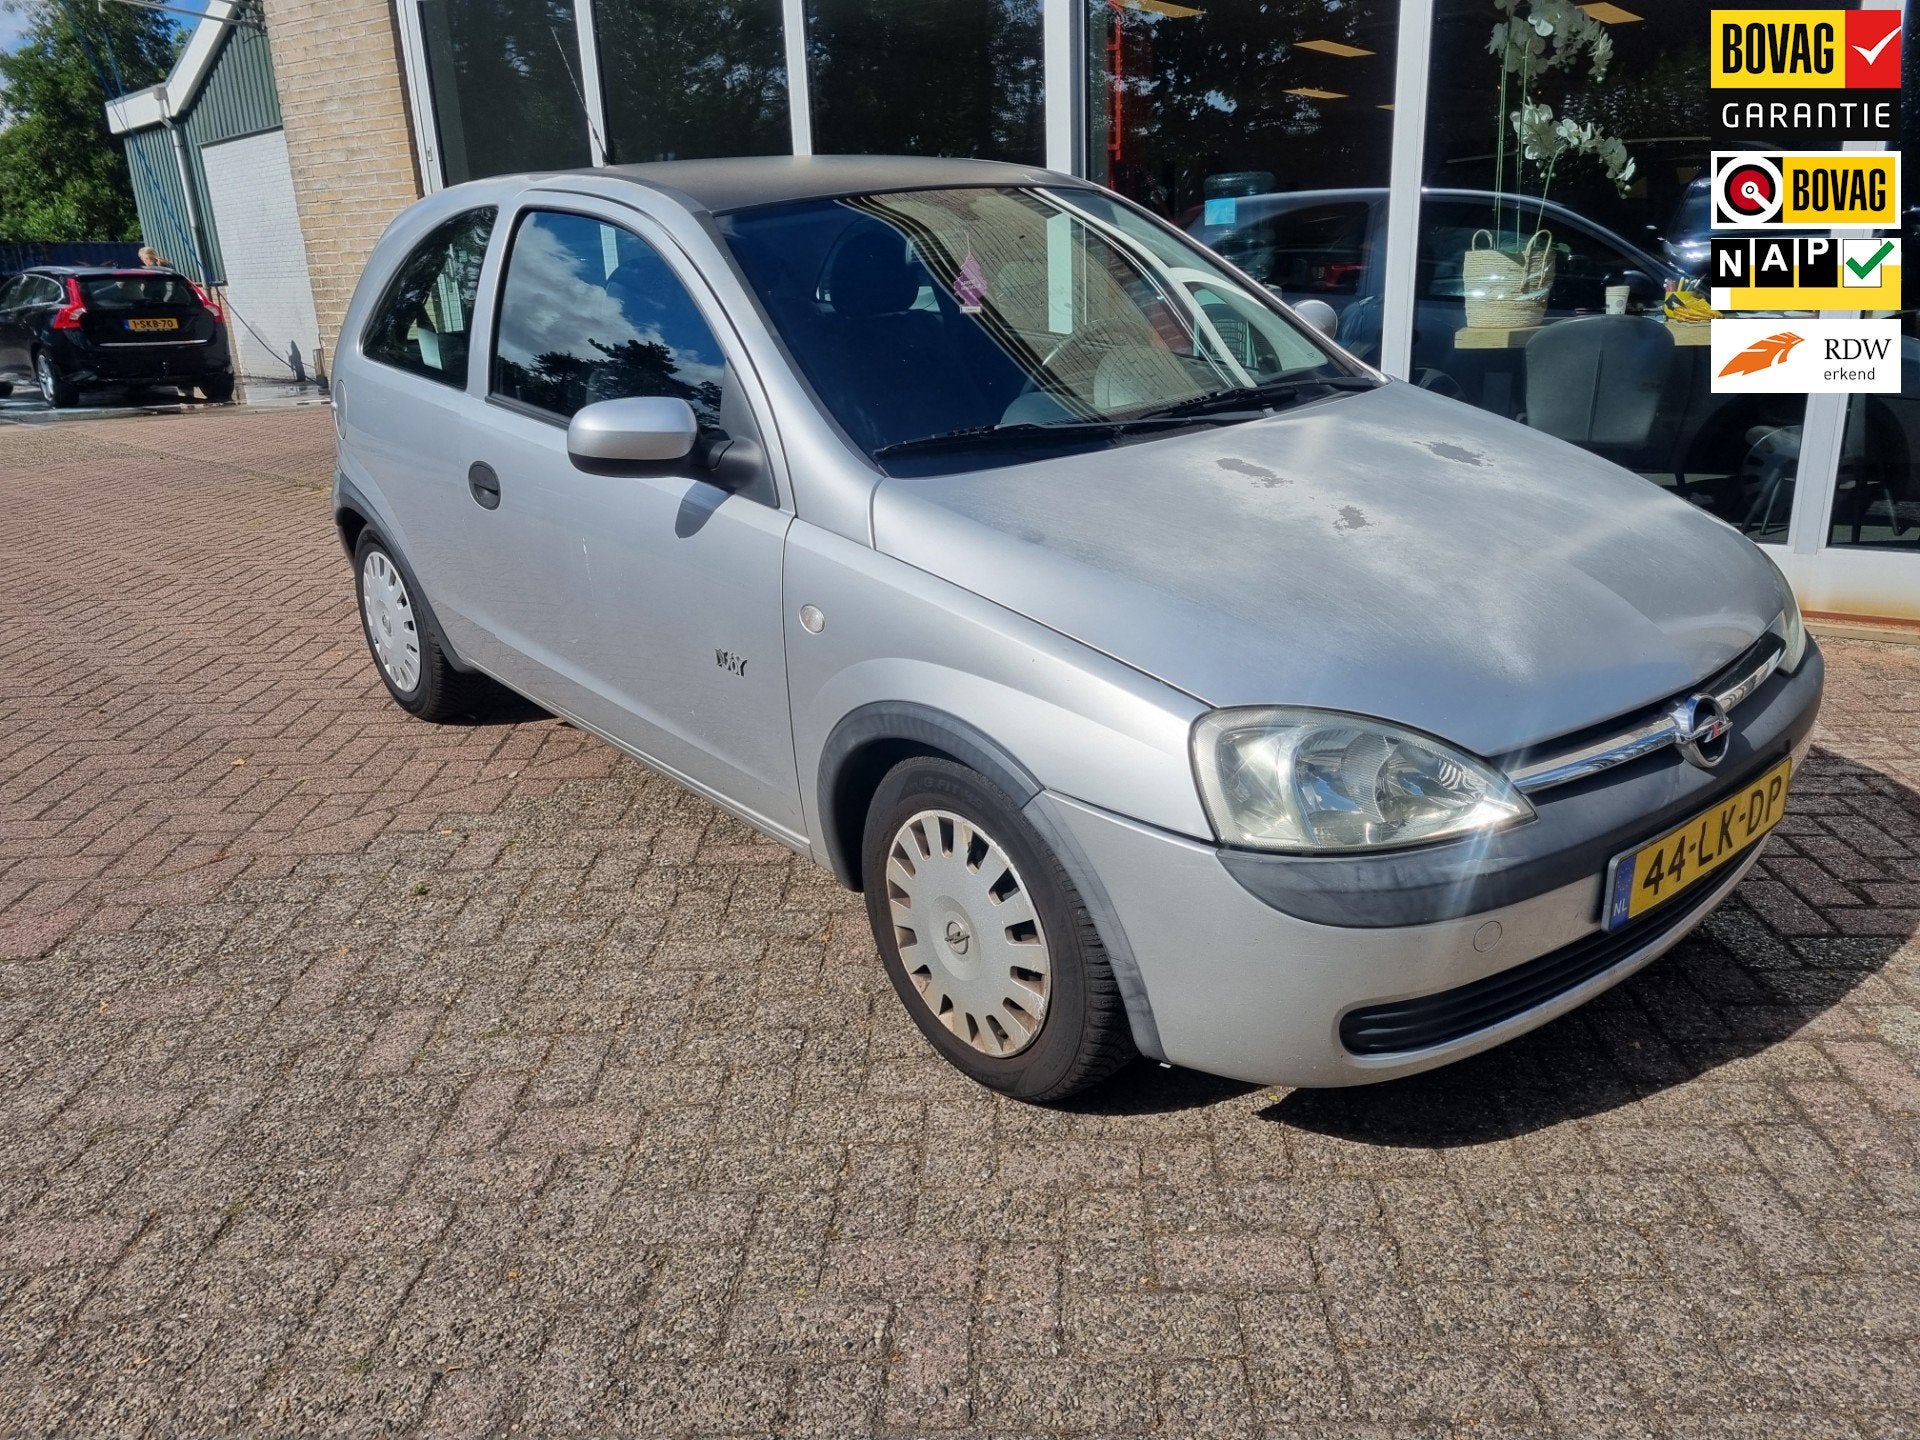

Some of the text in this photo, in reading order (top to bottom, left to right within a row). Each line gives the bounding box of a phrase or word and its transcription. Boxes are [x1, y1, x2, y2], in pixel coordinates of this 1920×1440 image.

[131, 319, 174, 328] 1-SKB-70
[1643, 775, 1782, 895] 44-LK-DP
[1613, 898, 1628, 917] NL
